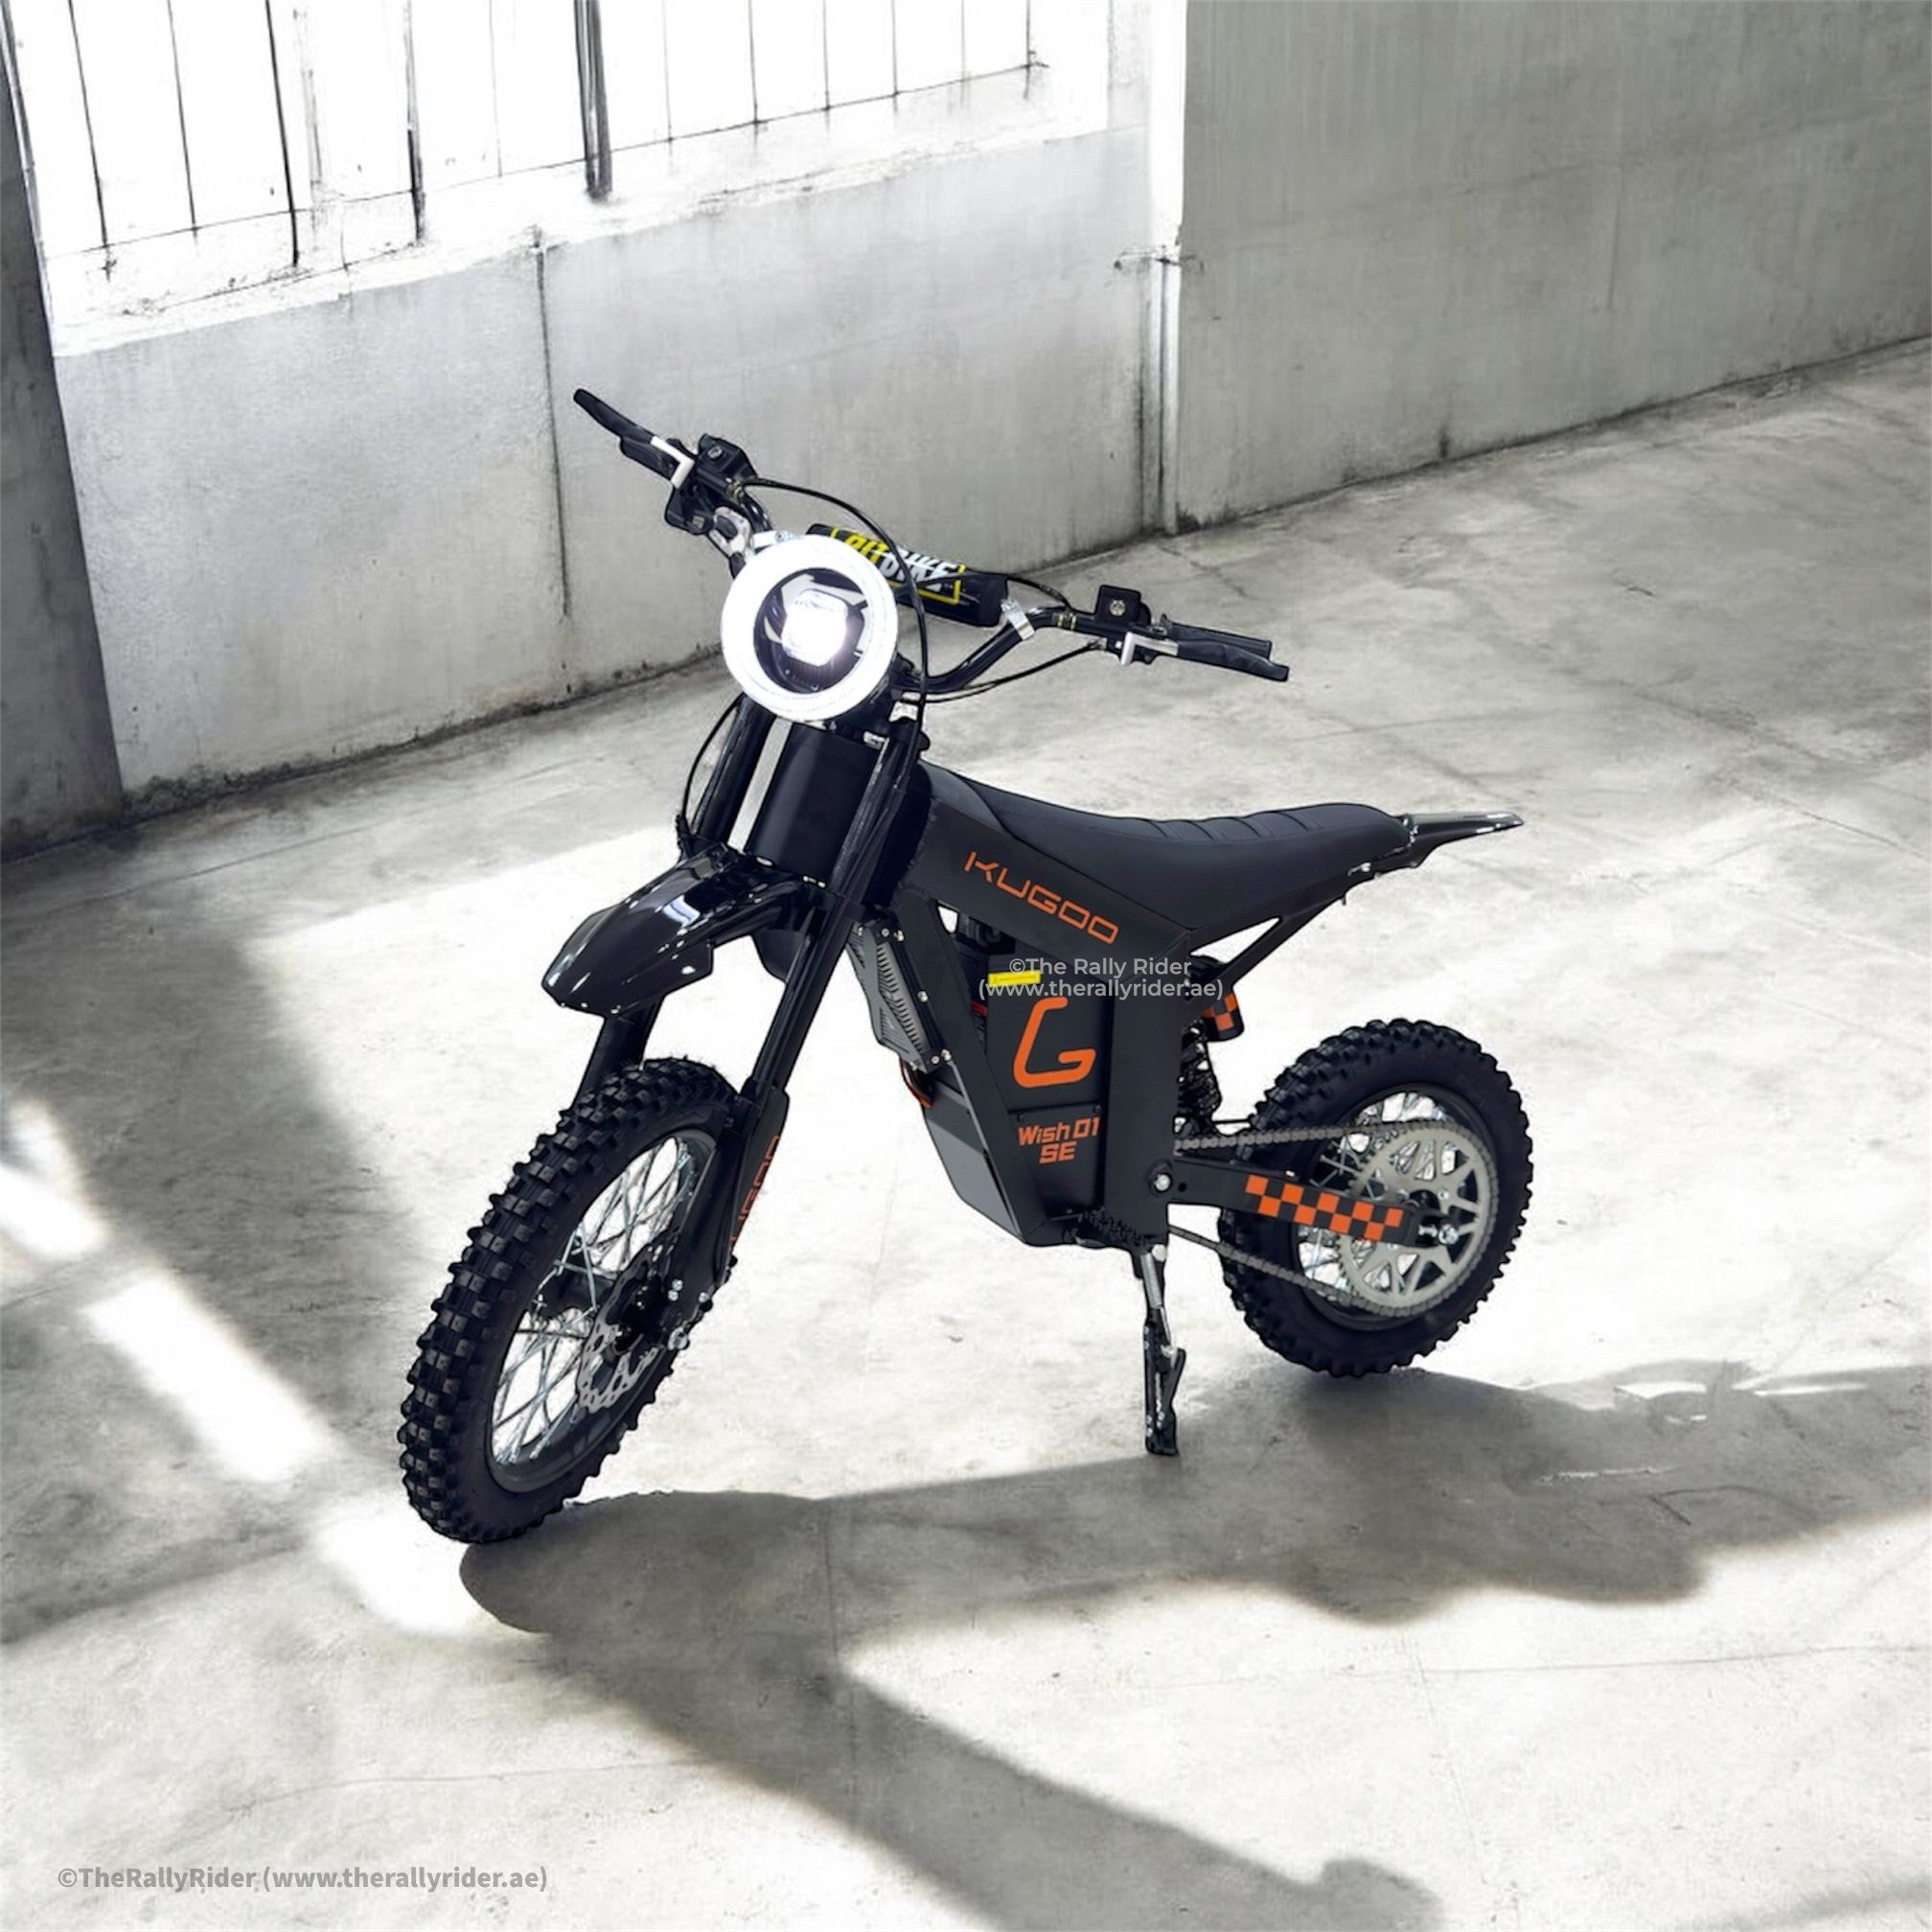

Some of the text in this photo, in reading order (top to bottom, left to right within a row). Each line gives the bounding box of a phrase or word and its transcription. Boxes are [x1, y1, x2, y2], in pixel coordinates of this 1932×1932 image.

[964, 851, 1119, 944] KUGOO
[1017, 1121, 1070, 1146] Wish
[1039, 1140, 1078, 1164] SE
